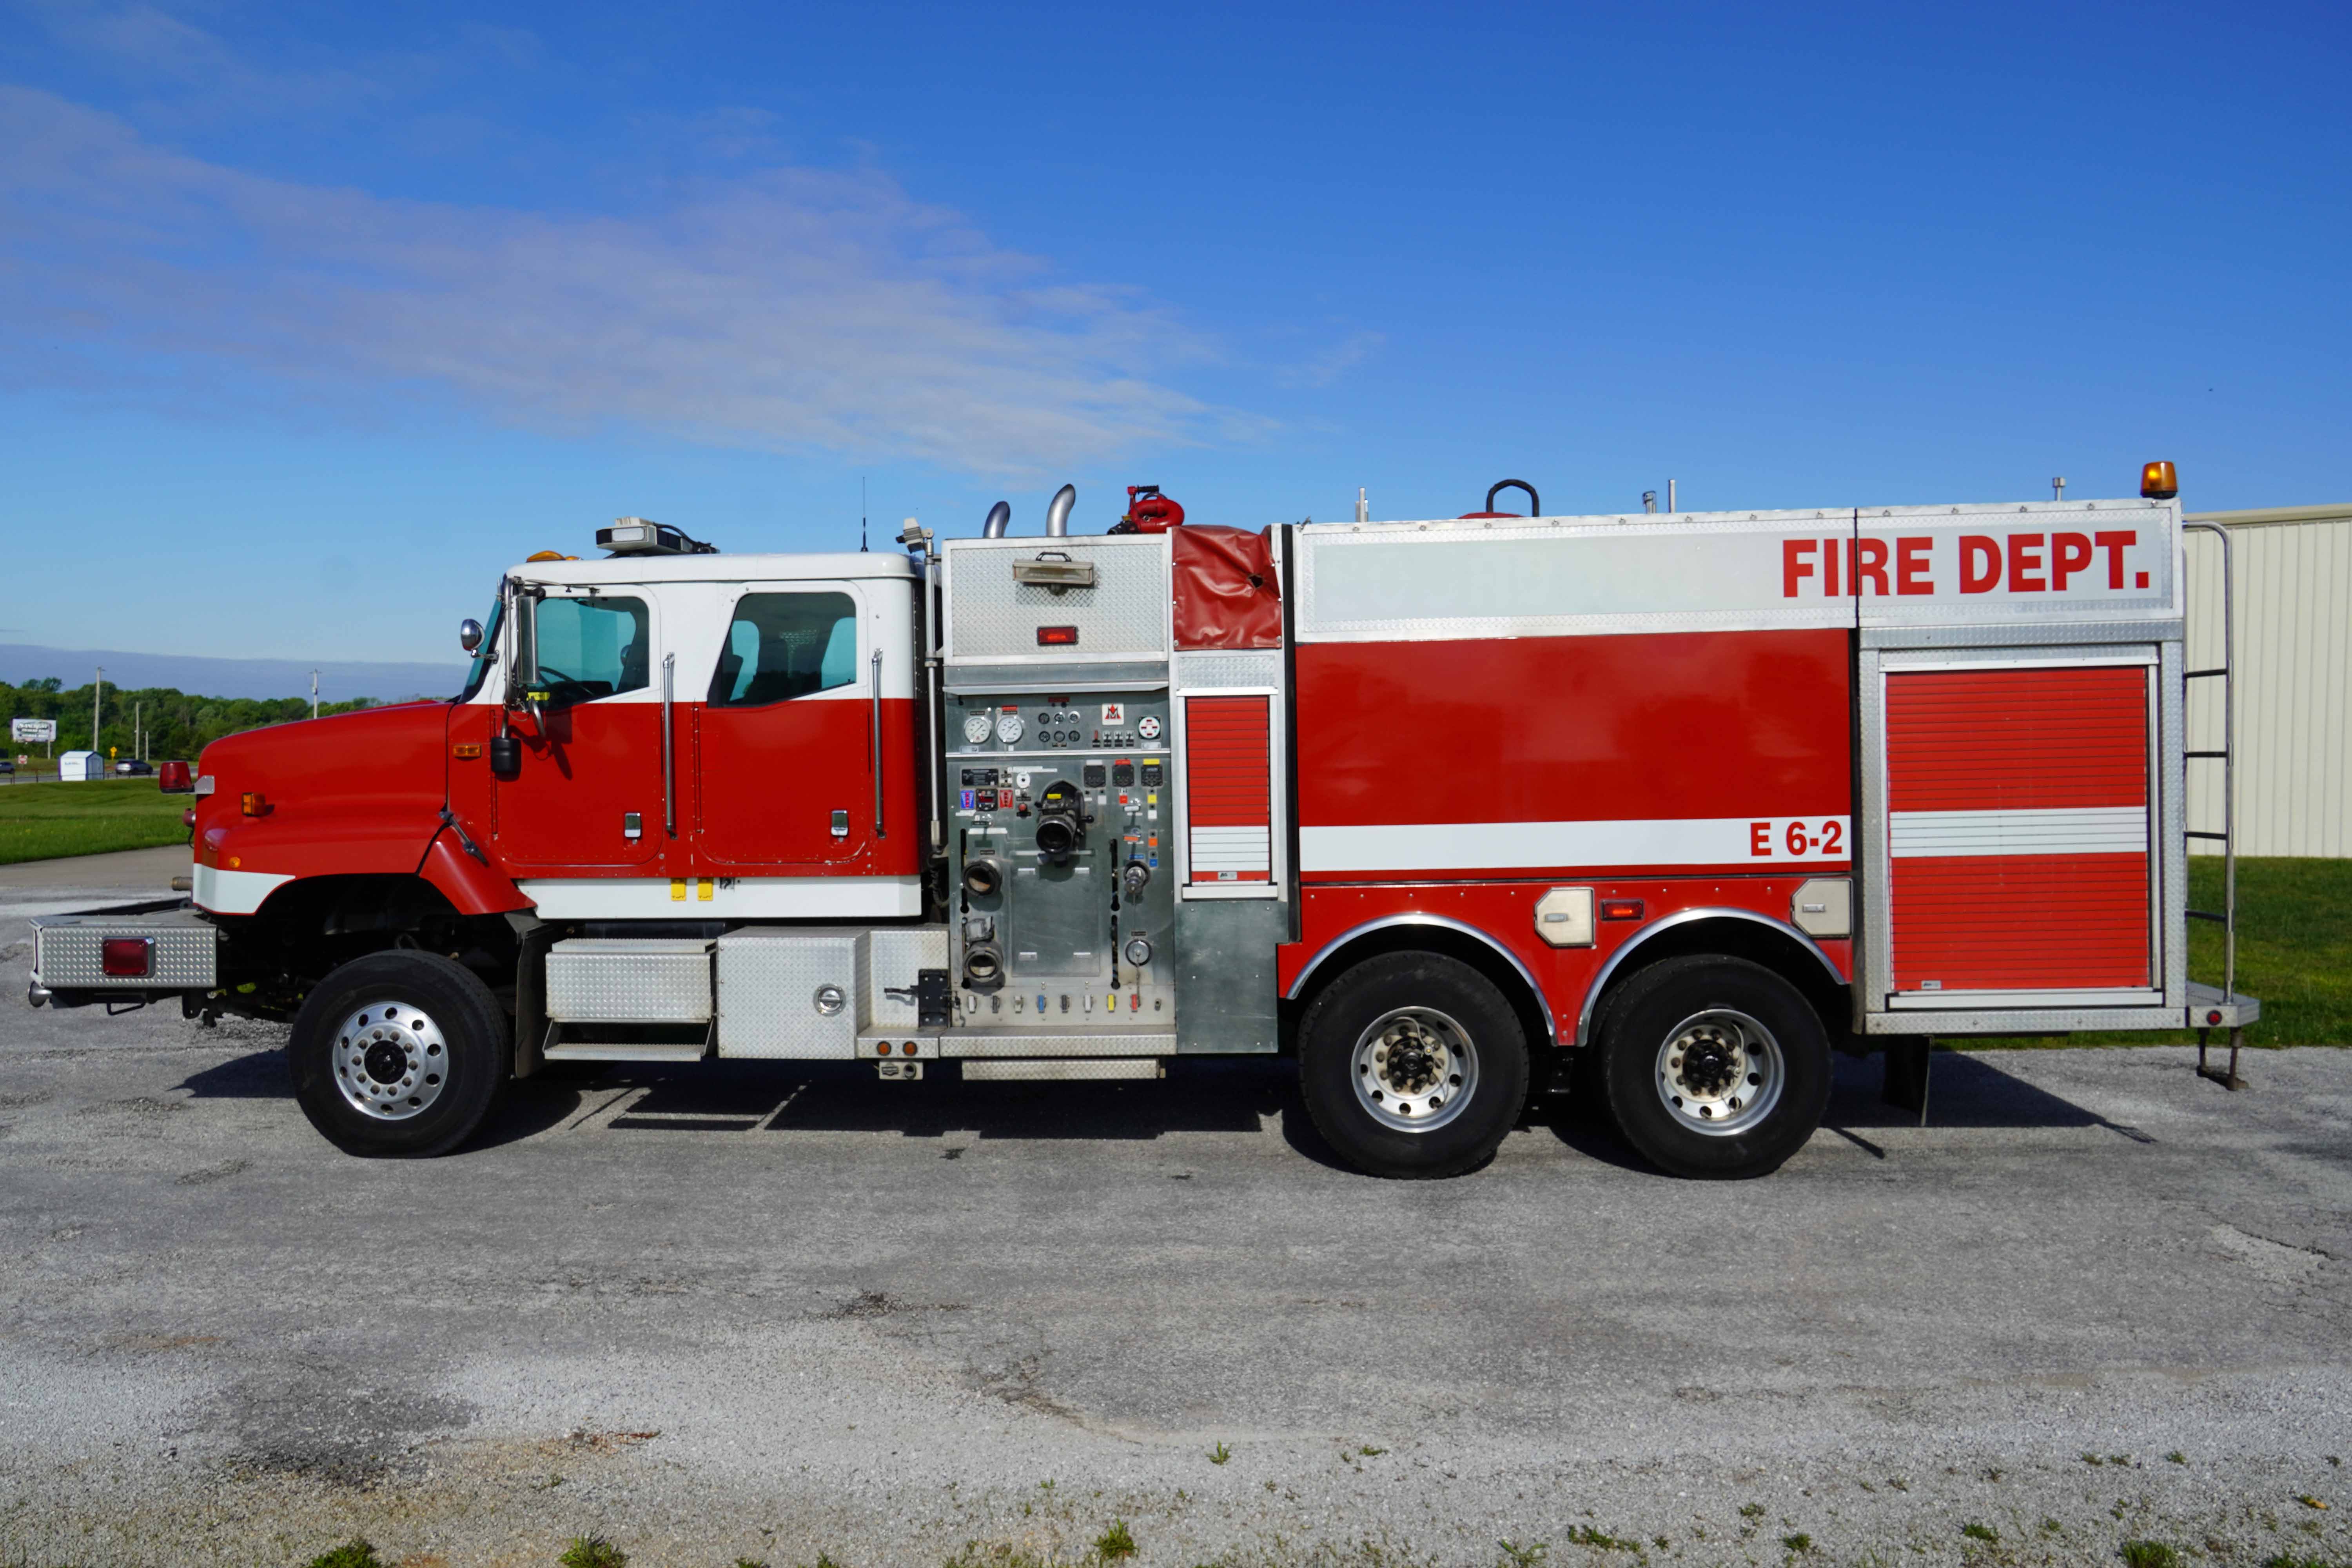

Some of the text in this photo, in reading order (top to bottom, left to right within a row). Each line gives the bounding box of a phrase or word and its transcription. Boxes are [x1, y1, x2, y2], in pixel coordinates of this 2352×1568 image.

[1783, 530, 2149, 597] FIRE DEPT.
[1750, 820, 1842, 857] E 6-2
